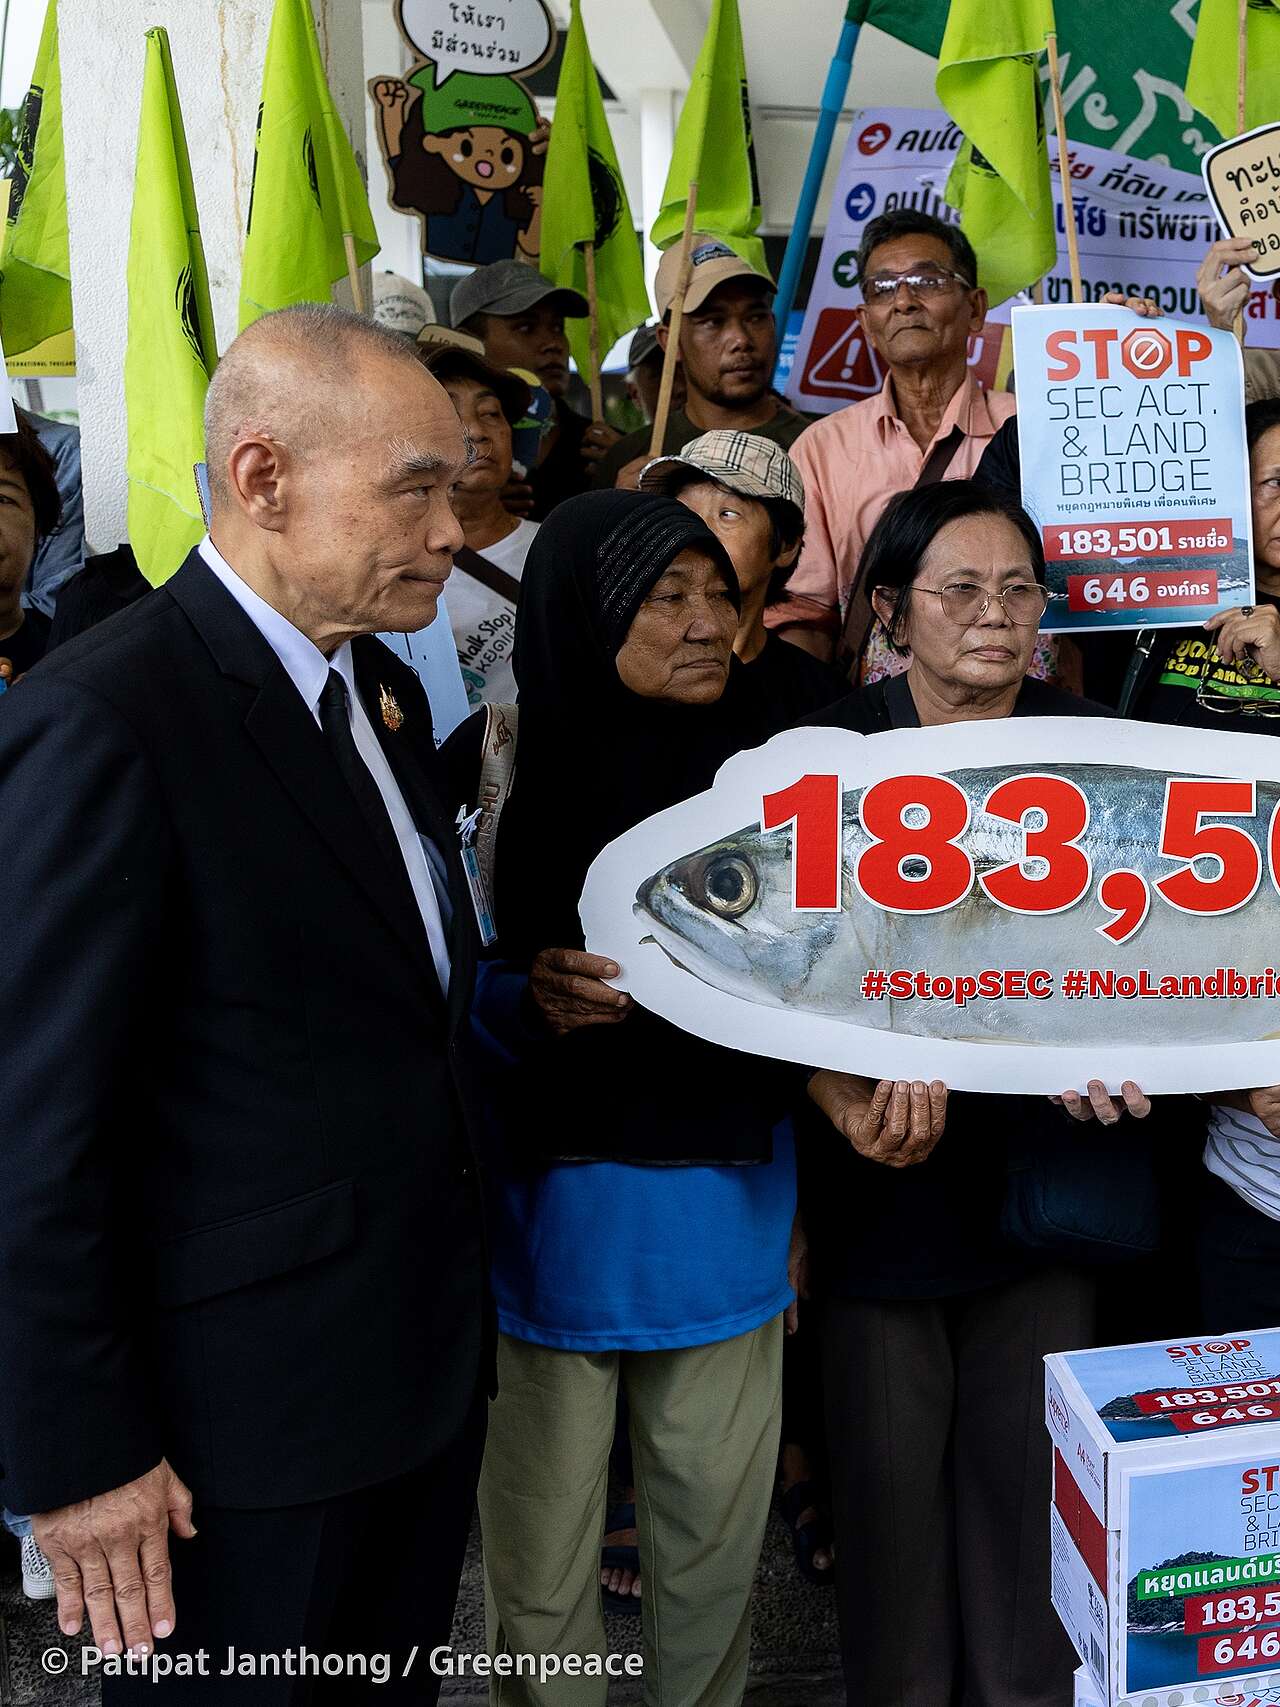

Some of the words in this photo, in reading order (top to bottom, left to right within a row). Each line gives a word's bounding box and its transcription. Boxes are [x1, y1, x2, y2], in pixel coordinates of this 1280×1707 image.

[431, 30, 521, 63] มีส่วนร่วม
[1045, 327, 1213, 382] STOP
[1047, 386, 1123, 420] SEC
[1136, 384, 1217, 418] ACT.
[1062, 426, 1088, 458] &
[1103, 422, 1207, 456] LAND
[1060, 459, 1213, 496] BRIDGE
[1056, 497, 1151, 514] หยุดกฎหมายพิเศษ
[1154, 493, 1217, 511] เพื่อคนพิเศษ
[1058, 526, 1174, 556] 183,501
[1178, 527, 1229, 550] รายชื่อ
[1083, 576, 1150, 605] 646
[1156, 578, 1211, 598] องค์กร
[860, 969, 1053, 1008] #StopSEC
[1165, 1338, 1252, 1358] STOP
[1171, 1355, 1215, 1368] SEC
[1221, 1351, 1263, 1362] ACT.
[1186, 1365, 1201, 1375] &
[1209, 1359, 1263, 1372] LAND
[1188, 1366, 1276, 1384] BRIDGE
[1192, 1404, 1273, 1425] 646
[1240, 1491, 1280, 1515] SEC
[1246, 1514, 1261, 1532] &
[1212, 1630, 1280, 1665] 646
